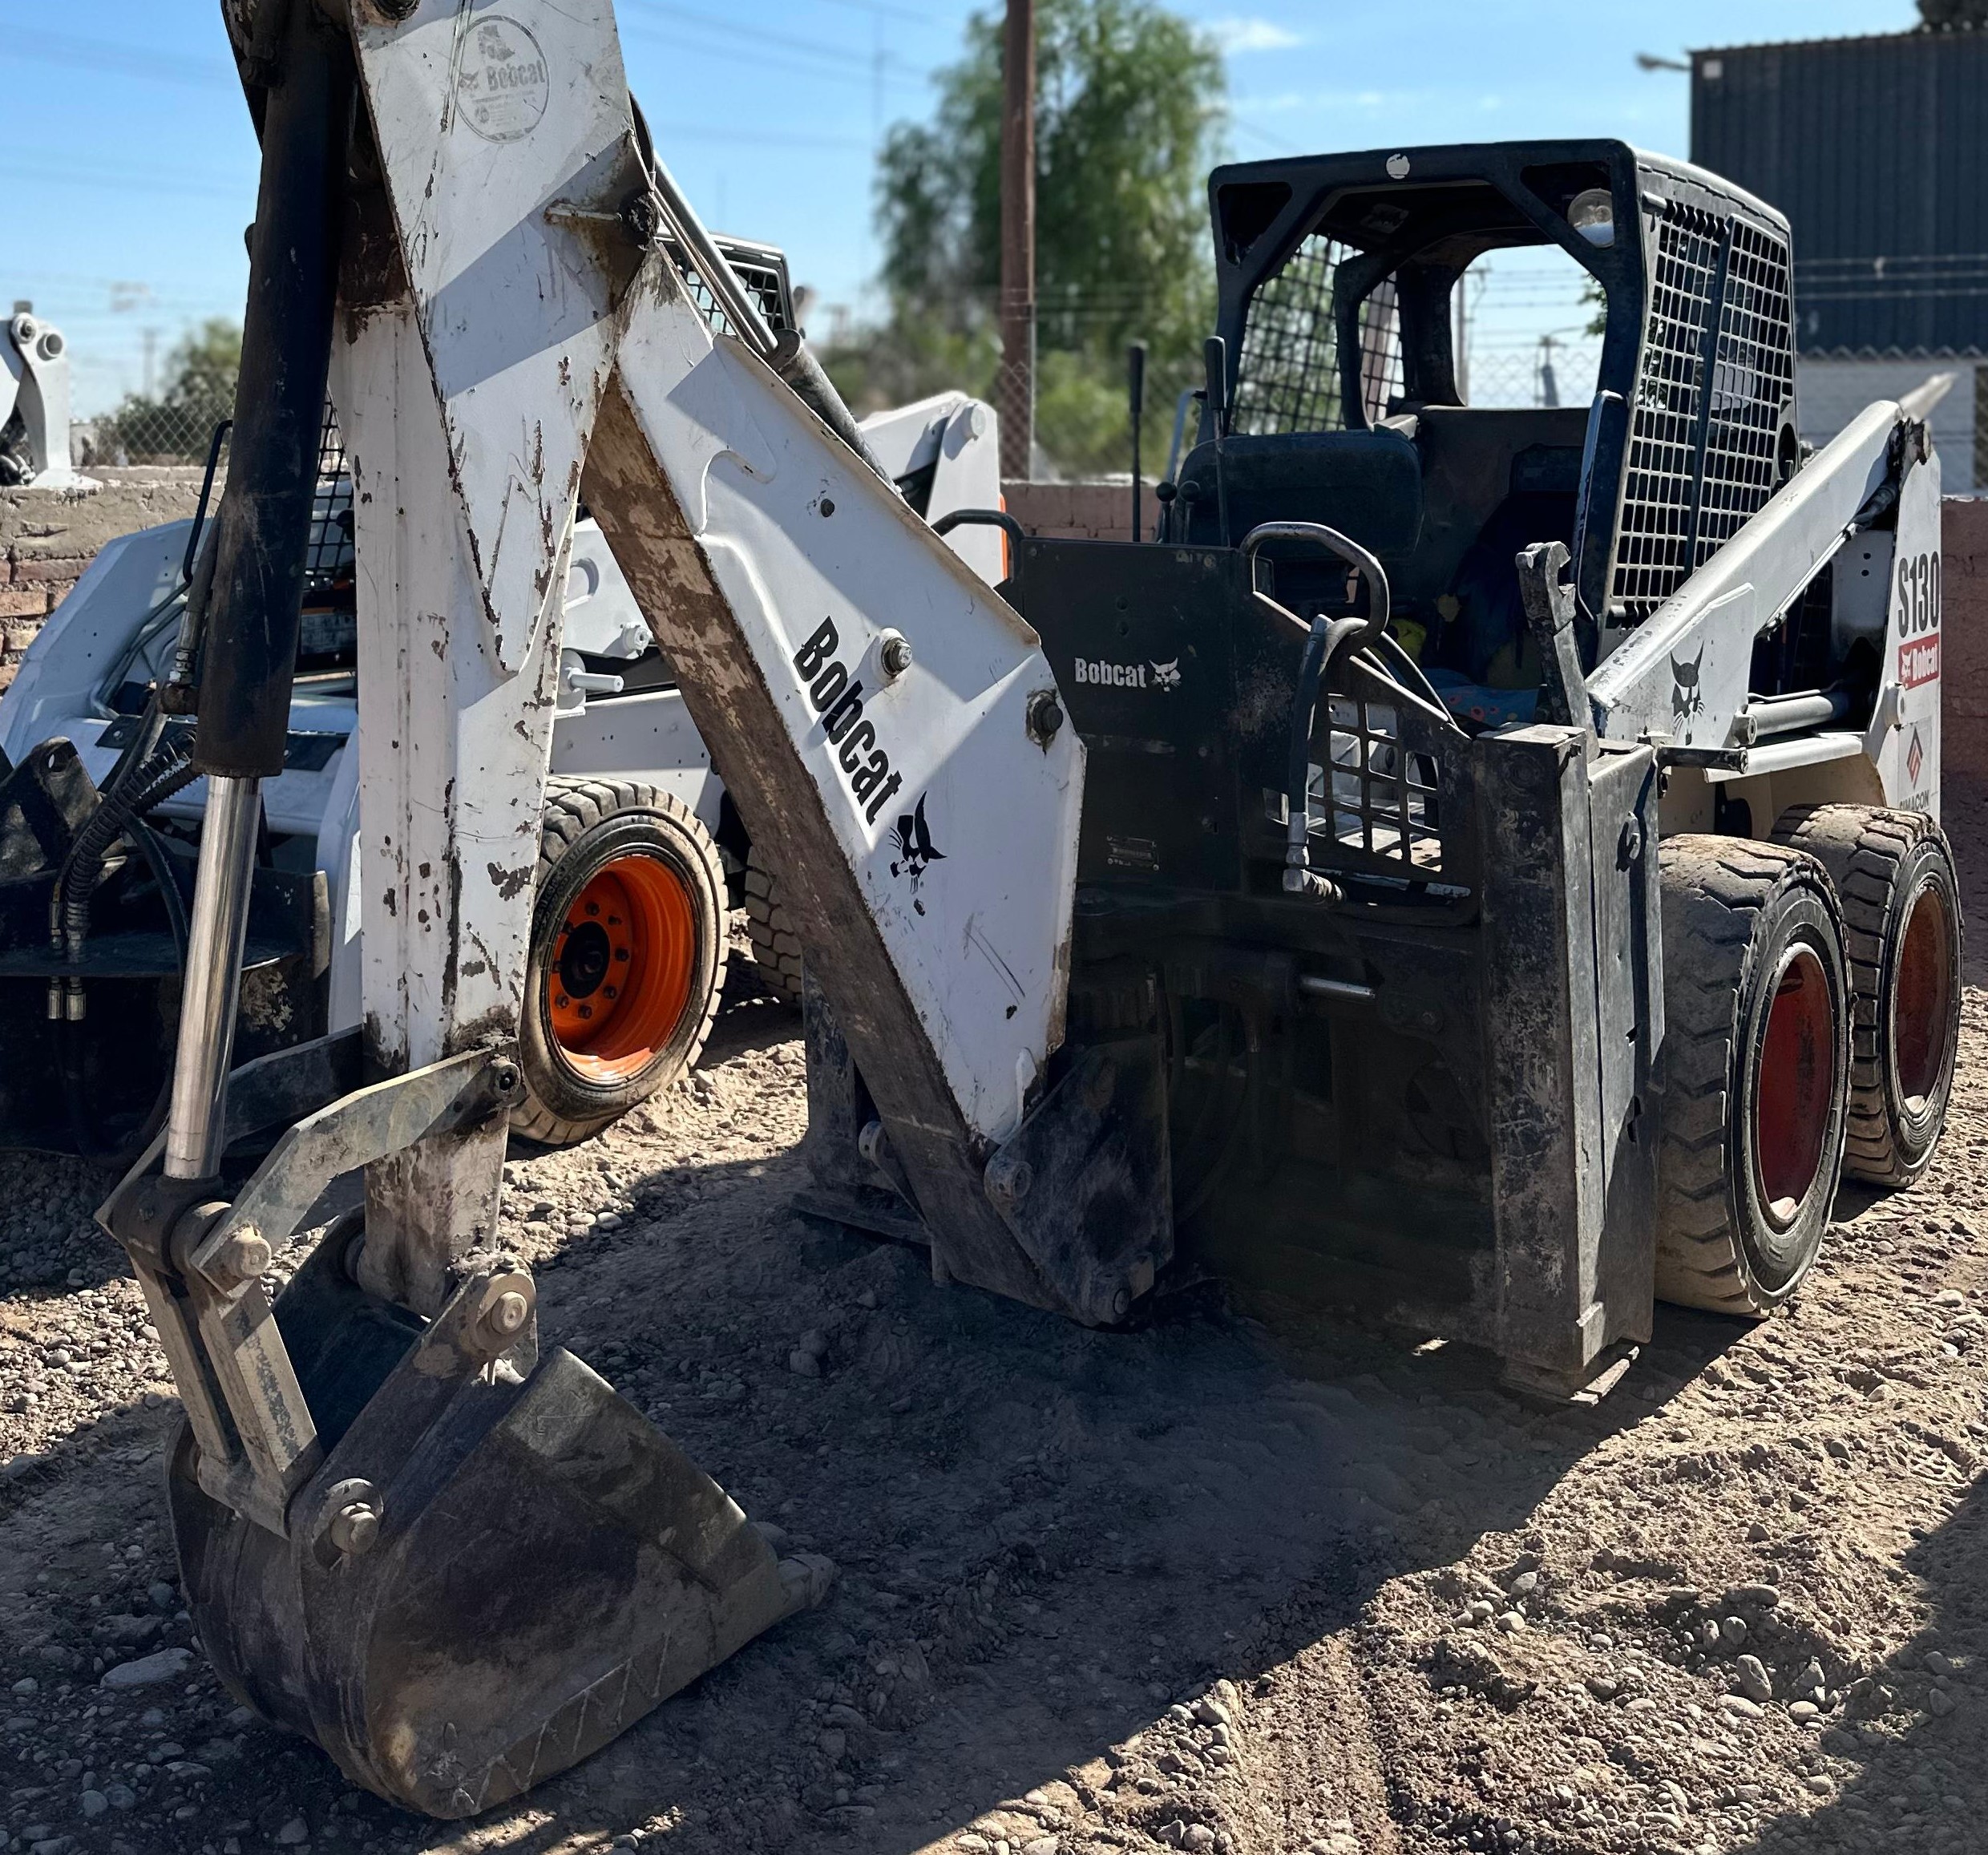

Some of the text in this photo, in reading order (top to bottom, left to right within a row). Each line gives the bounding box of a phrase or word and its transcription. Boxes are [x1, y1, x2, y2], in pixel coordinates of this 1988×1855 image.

[1897, 551, 1940, 638] S130
[1074, 657, 1147, 689] Bobcat
[1912, 642, 1938, 681] Bobcat
[793, 616, 903, 826] Bobcat
